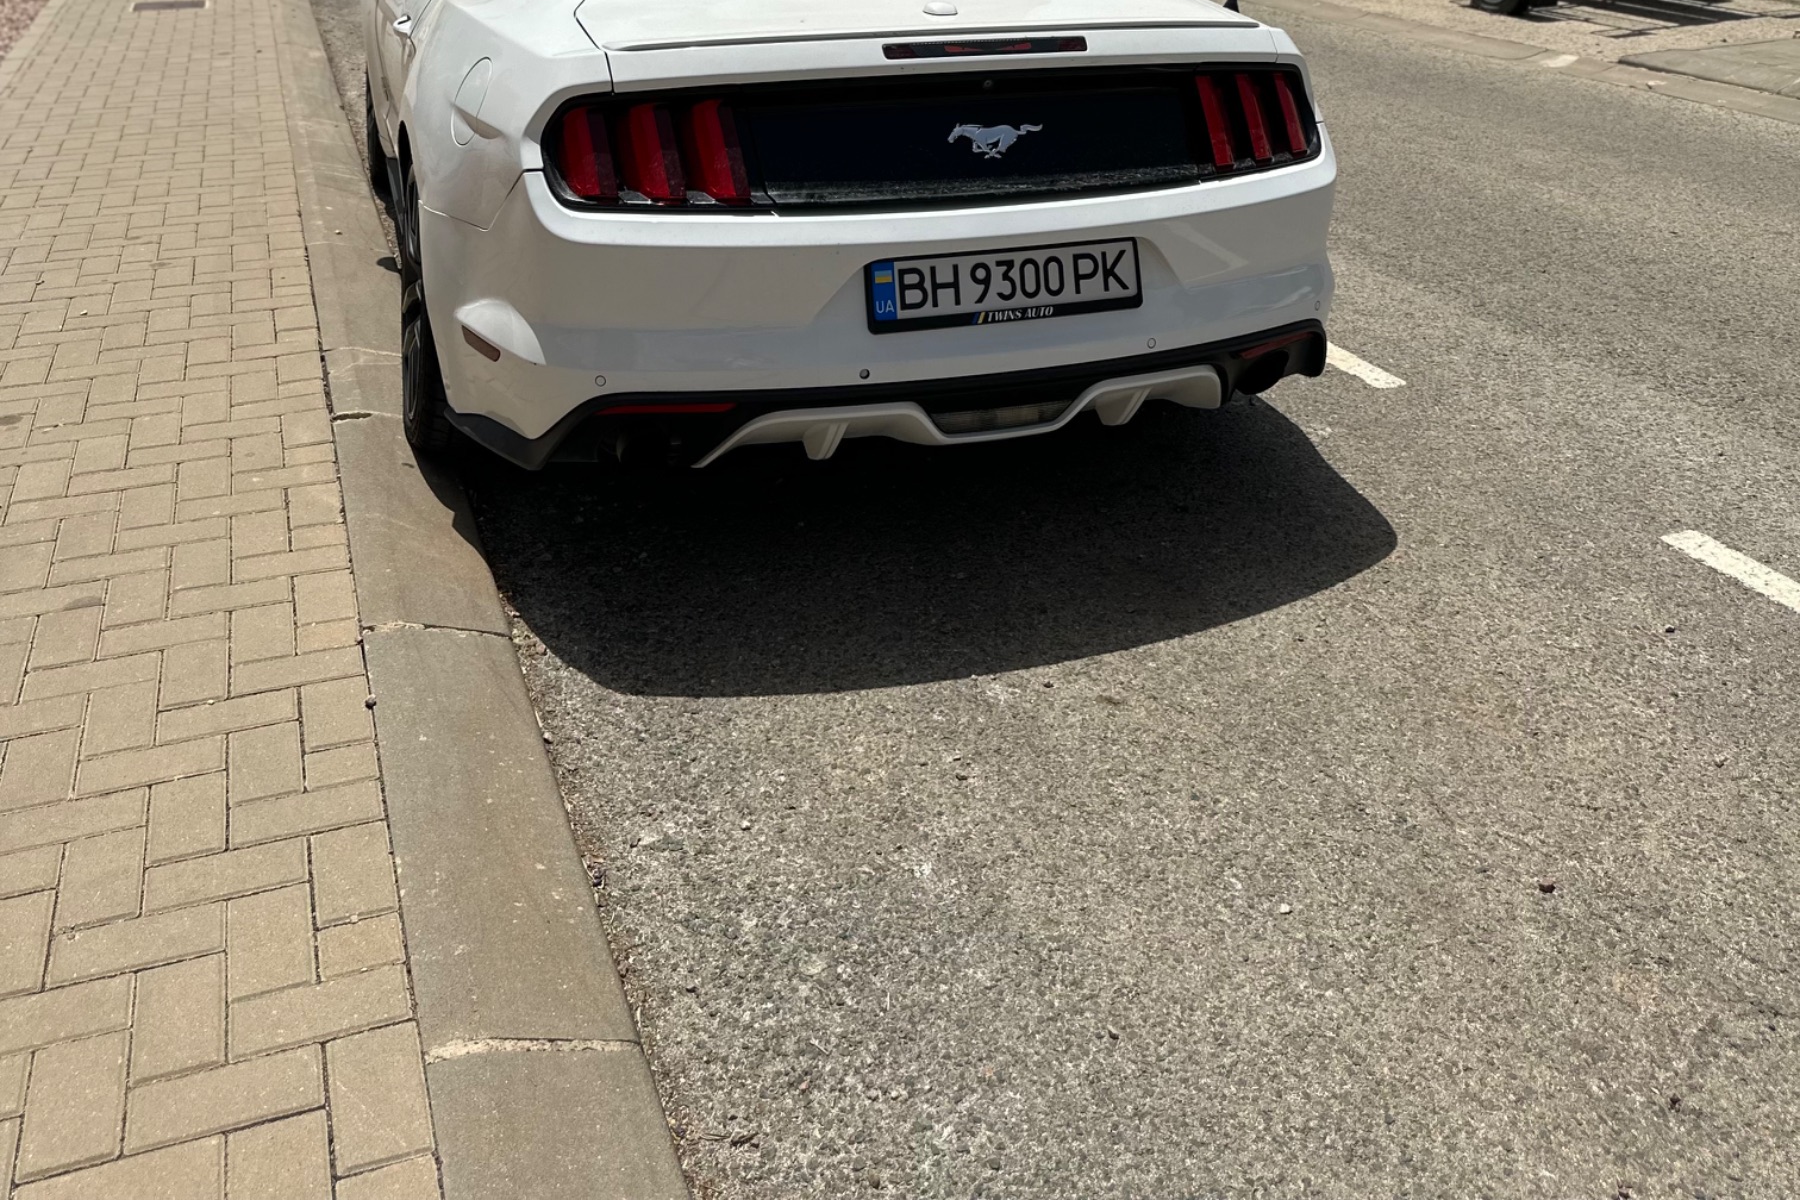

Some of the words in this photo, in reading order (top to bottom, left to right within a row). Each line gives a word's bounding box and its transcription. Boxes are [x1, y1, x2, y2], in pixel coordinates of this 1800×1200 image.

[898, 263, 961, 311] BH
[969, 255, 1065, 304] 9300
[1072, 249, 1130, 295] PK
[875, 299, 895, 314] UA
[986, 308, 1023, 322] TWINS
[1024, 306, 1054, 319] AUTO
